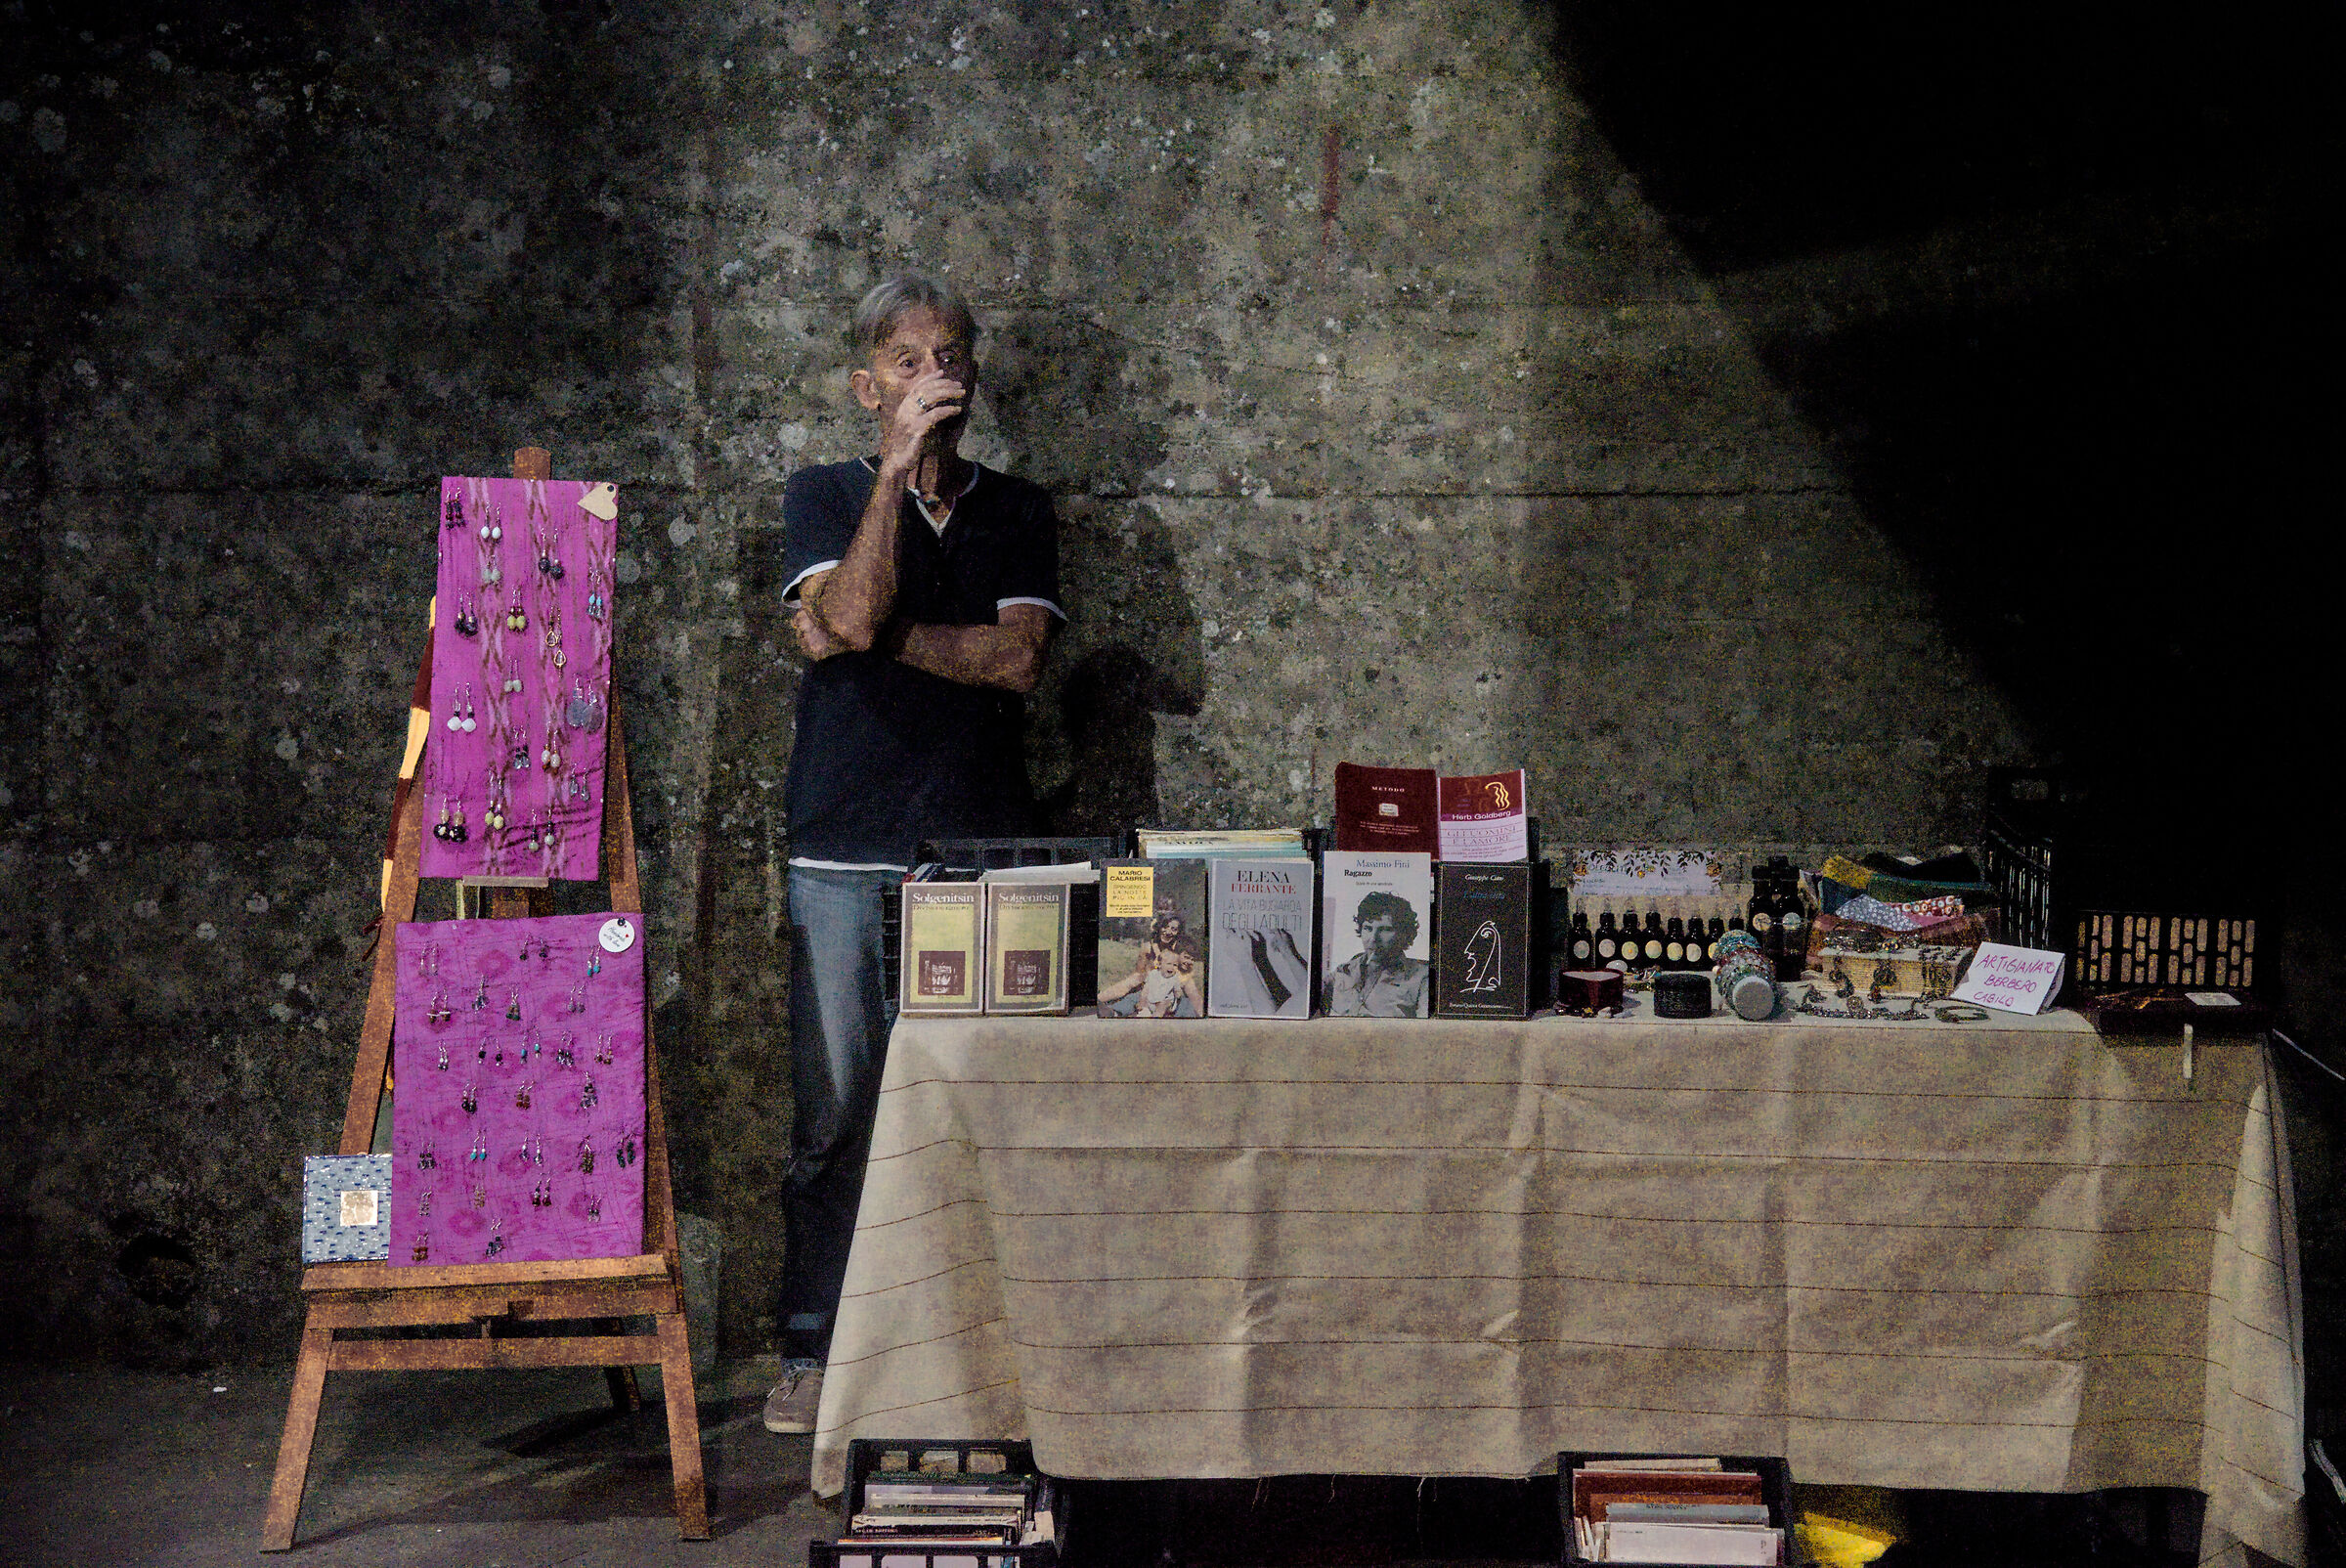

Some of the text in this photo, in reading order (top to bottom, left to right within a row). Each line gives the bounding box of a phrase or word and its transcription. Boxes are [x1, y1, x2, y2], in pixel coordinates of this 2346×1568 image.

[1474, 810, 1511, 820] Goldberg
[1356, 859, 1410, 868] Massimo Fini
[1238, 870, 1290, 884] ELENA
[1344, 869, 1372, 878] Ragazzo
[1231, 883, 1297, 894] FERRANTE
[912, 893, 975, 904] Solgenitsin
[998, 892, 1060, 903] Solgenitsin
[1222, 898, 1236, 910] LA
[1222, 912, 1302, 932] DEGLI ADULTI
[1976, 954, 2056, 974] ARTIGIANATO
[1983, 974, 2037, 993] BERBERO
[1973, 991, 2015, 1007] CABILO
